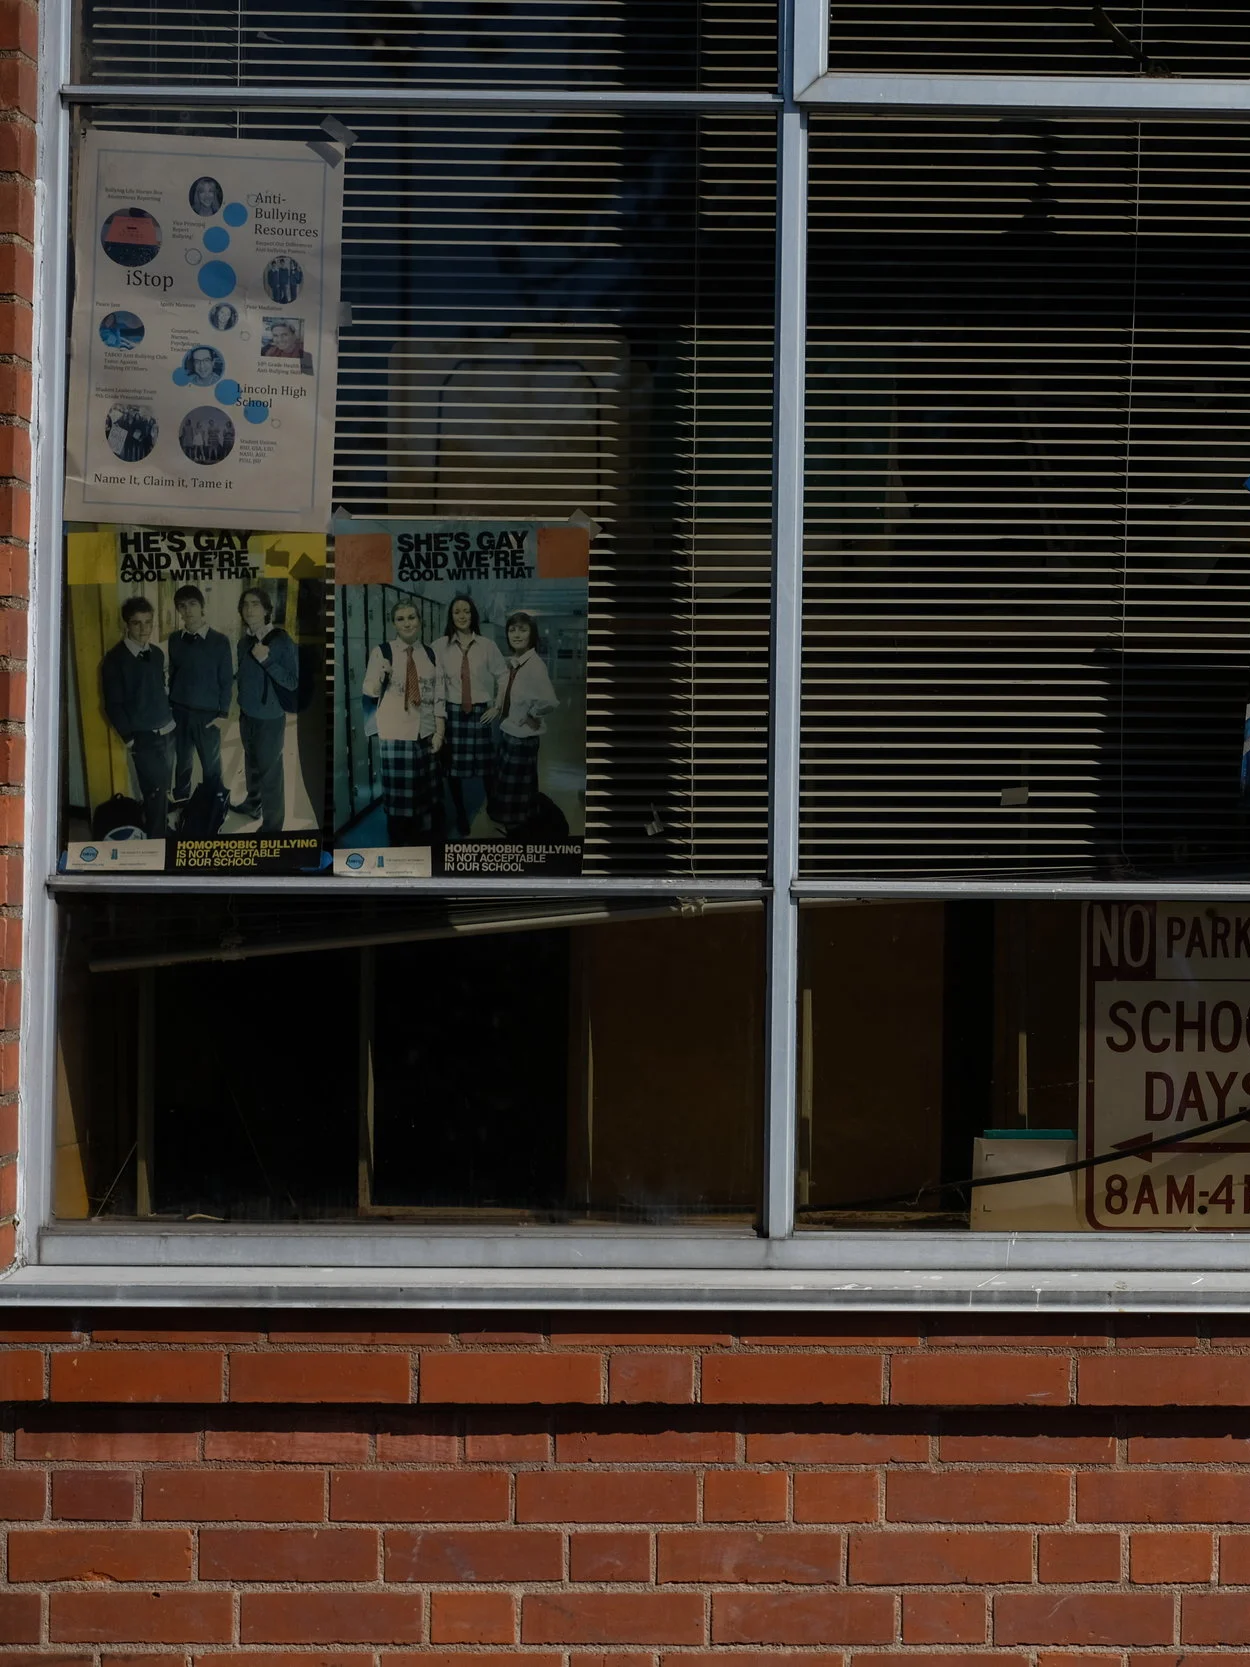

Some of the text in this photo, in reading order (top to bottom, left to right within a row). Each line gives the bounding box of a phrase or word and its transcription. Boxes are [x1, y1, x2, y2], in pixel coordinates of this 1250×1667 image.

[254, 192, 287, 204] Anti-
[255, 207, 307, 224] Bullying
[254, 223, 319, 238] Resources
[127, 270, 174, 292] iStop
[236, 383, 307, 399] Lincoln High
[235, 396, 273, 408] School
[94, 473, 126, 484] Name
[143, 475, 175, 487] Claim
[177, 477, 188, 489] it,
[190, 477, 222, 489] Tame
[224, 479, 233, 489] it
[120, 529, 253, 553] HE'S GAY
[397, 530, 529, 553] SHE'S GAY
[121, 550, 250, 571] AND WE'RE
[398, 550, 525, 570] AND WE'RE
[120, 567, 260, 583] COOL WITH THAT
[398, 566, 535, 582] COOL WITH THAT
[177, 838, 318, 850] HOMOPHOBIC BULLYING
[444, 843, 582, 854] HOMOPHOBIC BULLYING
[176, 848, 281, 859] IS NOT ACCEPTABLE
[444, 853, 547, 863] IS NOT ACCEPTABLE
[175, 857, 258, 867] IN OUR SCHOOL
[444, 862, 525, 872] IN OUR SCHOOL
[1093, 904, 1151, 968] NO
